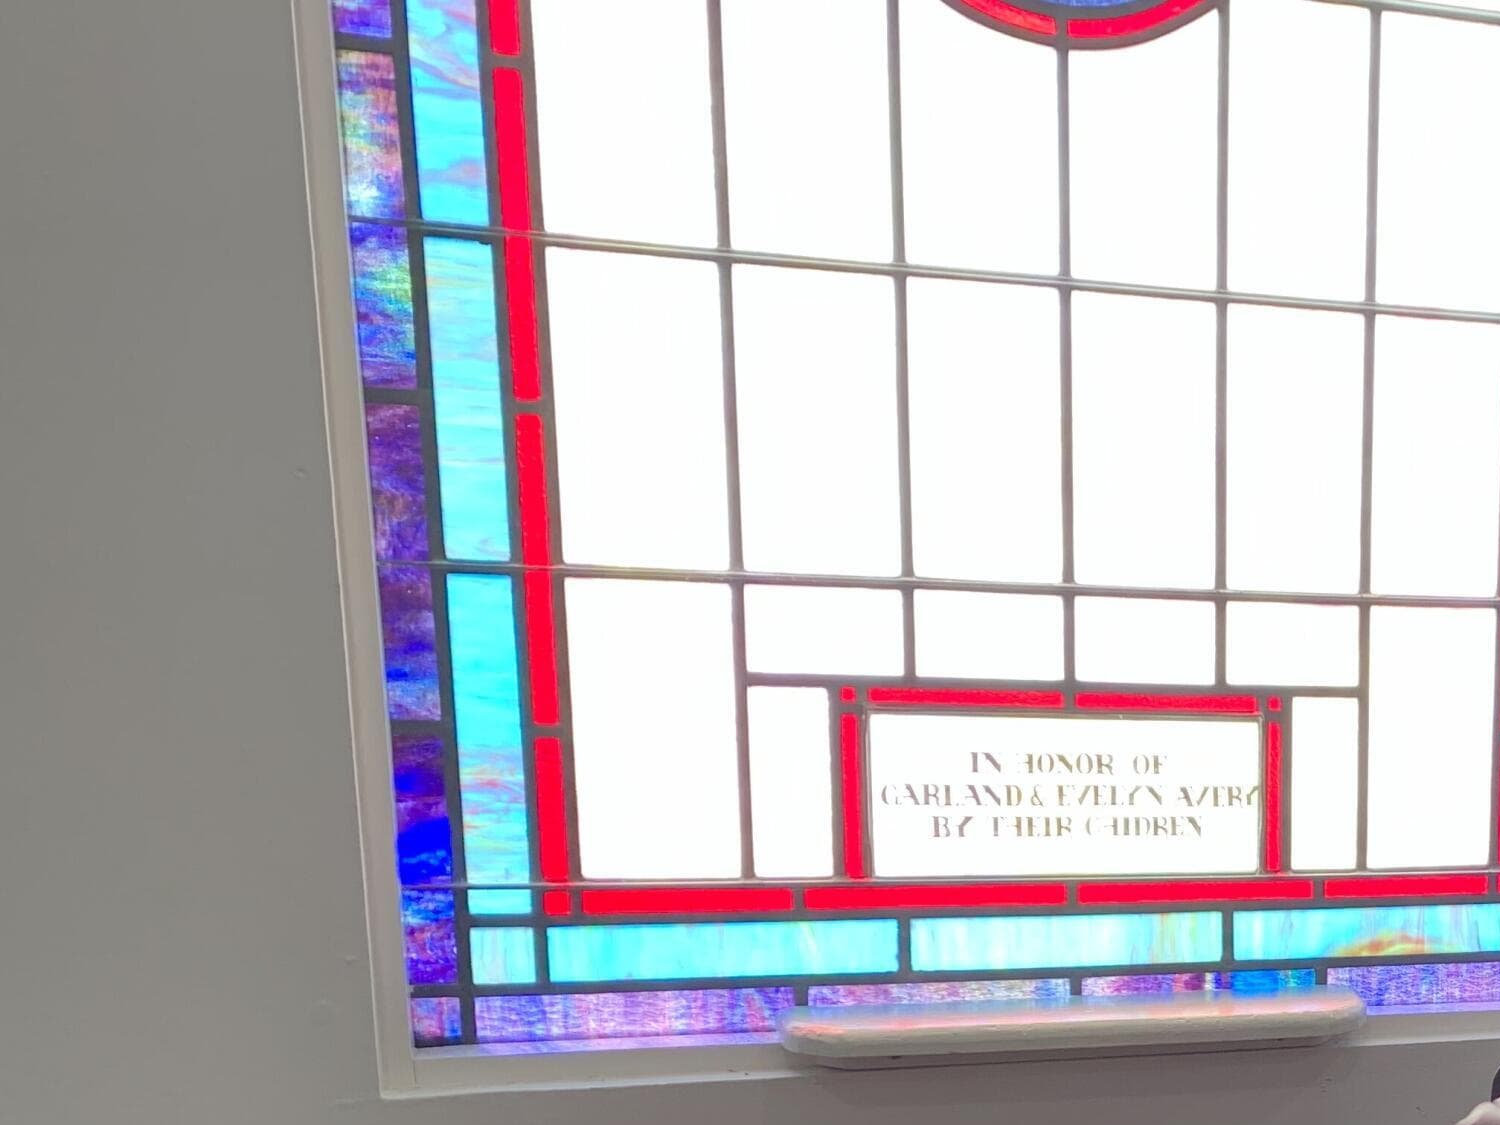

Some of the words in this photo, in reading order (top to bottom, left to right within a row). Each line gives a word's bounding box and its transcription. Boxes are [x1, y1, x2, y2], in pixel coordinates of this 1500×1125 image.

[970, 751, 1003, 774] IN
[1018, 751, 1115, 775] HONOR
[1132, 753, 1169, 775] OF
[880, 783, 1023, 807] GARLAND
[1030, 785, 1045, 807] &
[932, 815, 974, 838] BY
[990, 815, 1073, 838] THEIR
